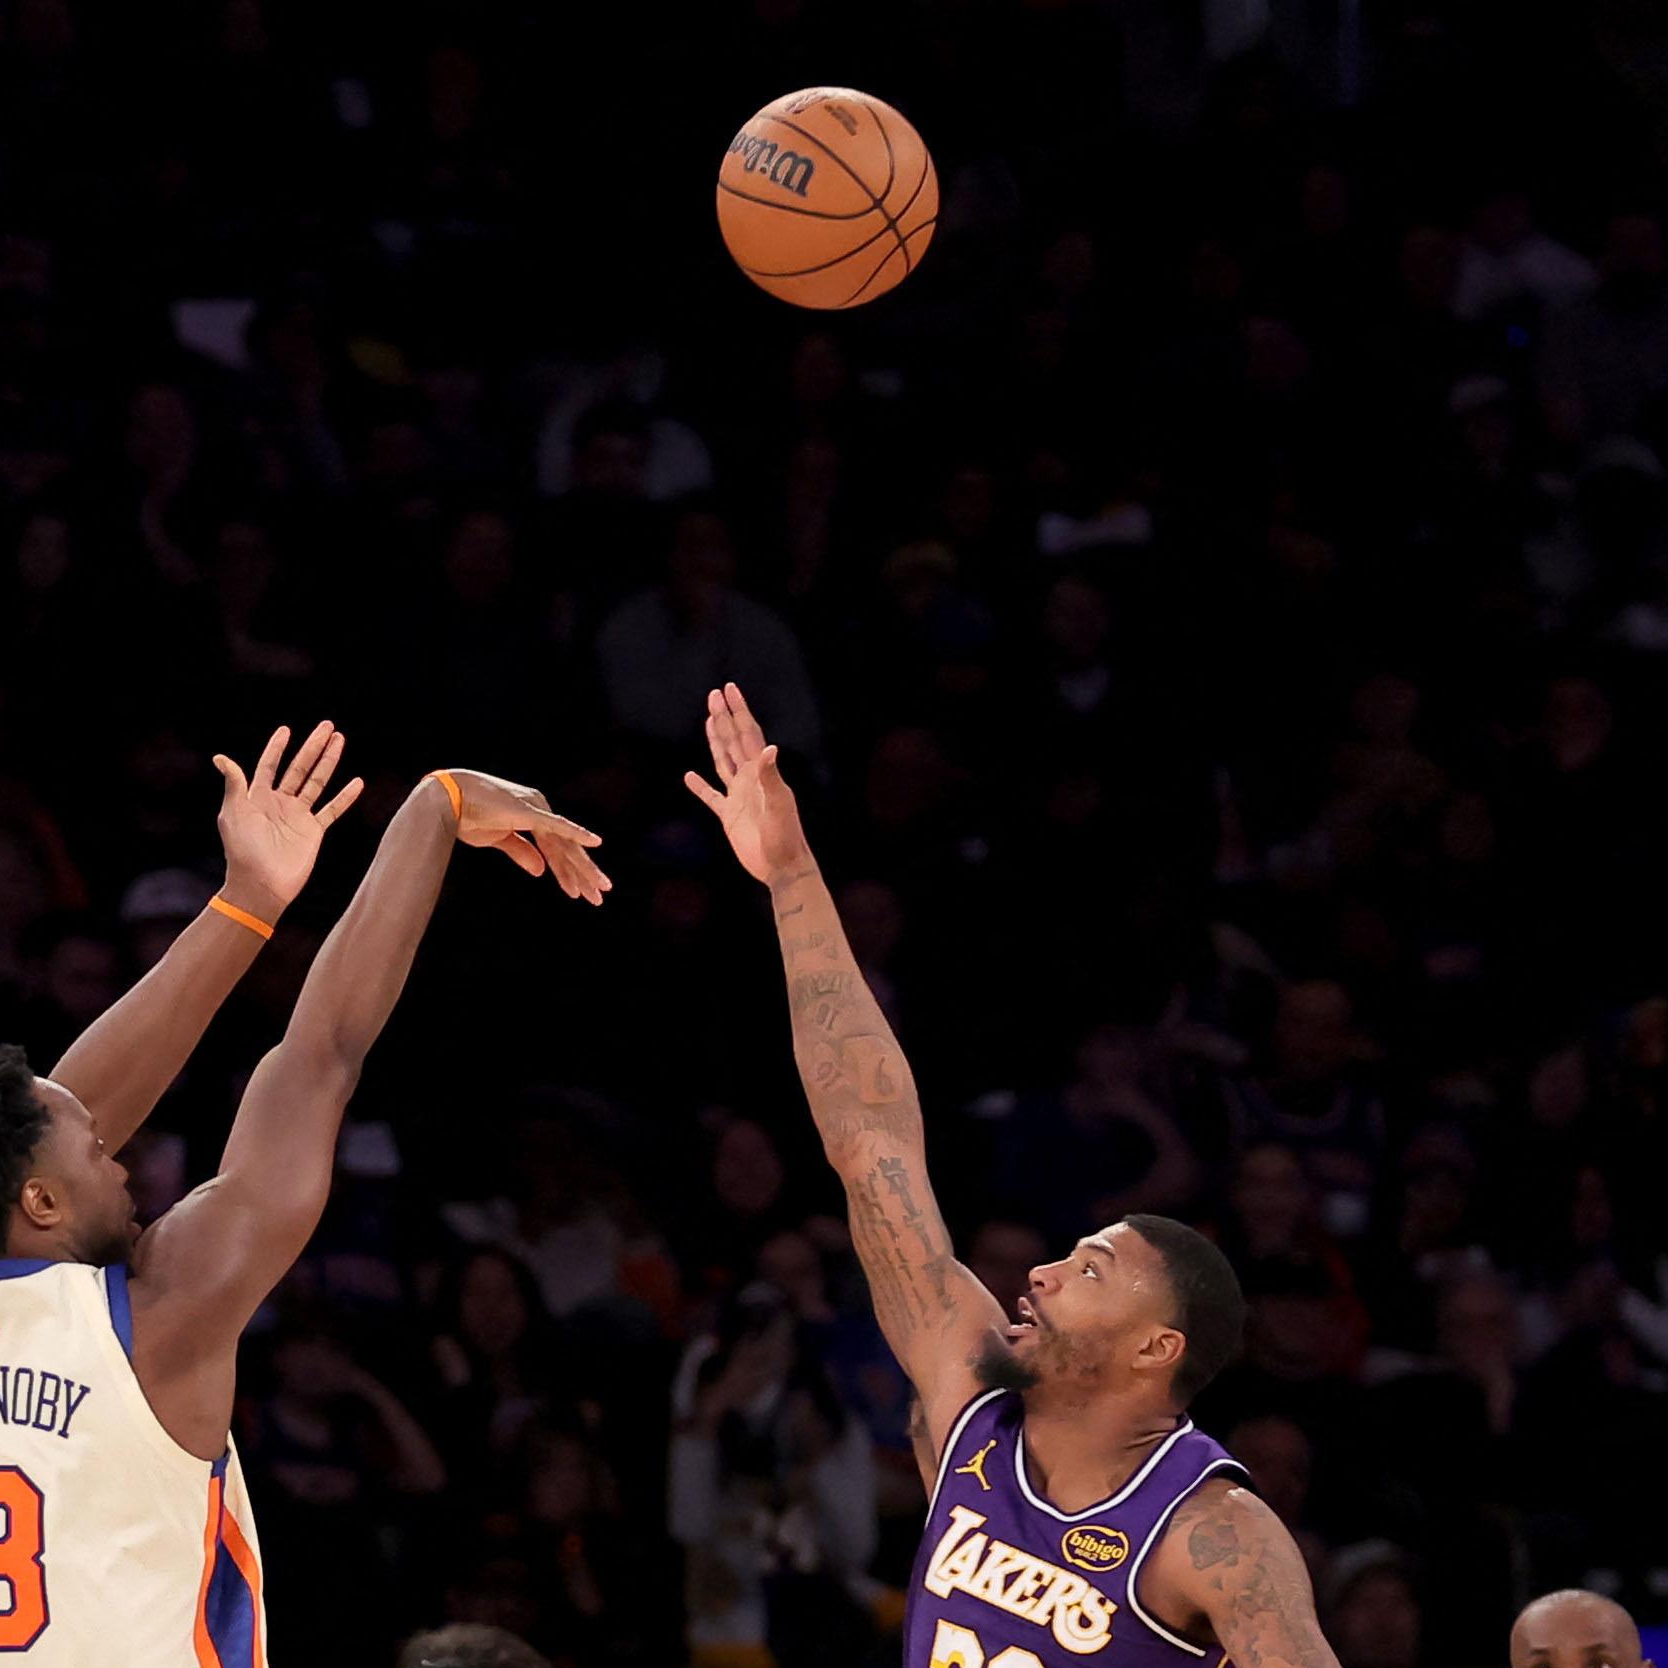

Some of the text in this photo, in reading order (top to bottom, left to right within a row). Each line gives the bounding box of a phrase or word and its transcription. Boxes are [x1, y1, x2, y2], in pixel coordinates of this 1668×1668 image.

[729, 132, 814, 198] Wilso
[924, 1503, 1119, 1655] LAKERS
[1069, 1532, 1125, 1561] bibigo
